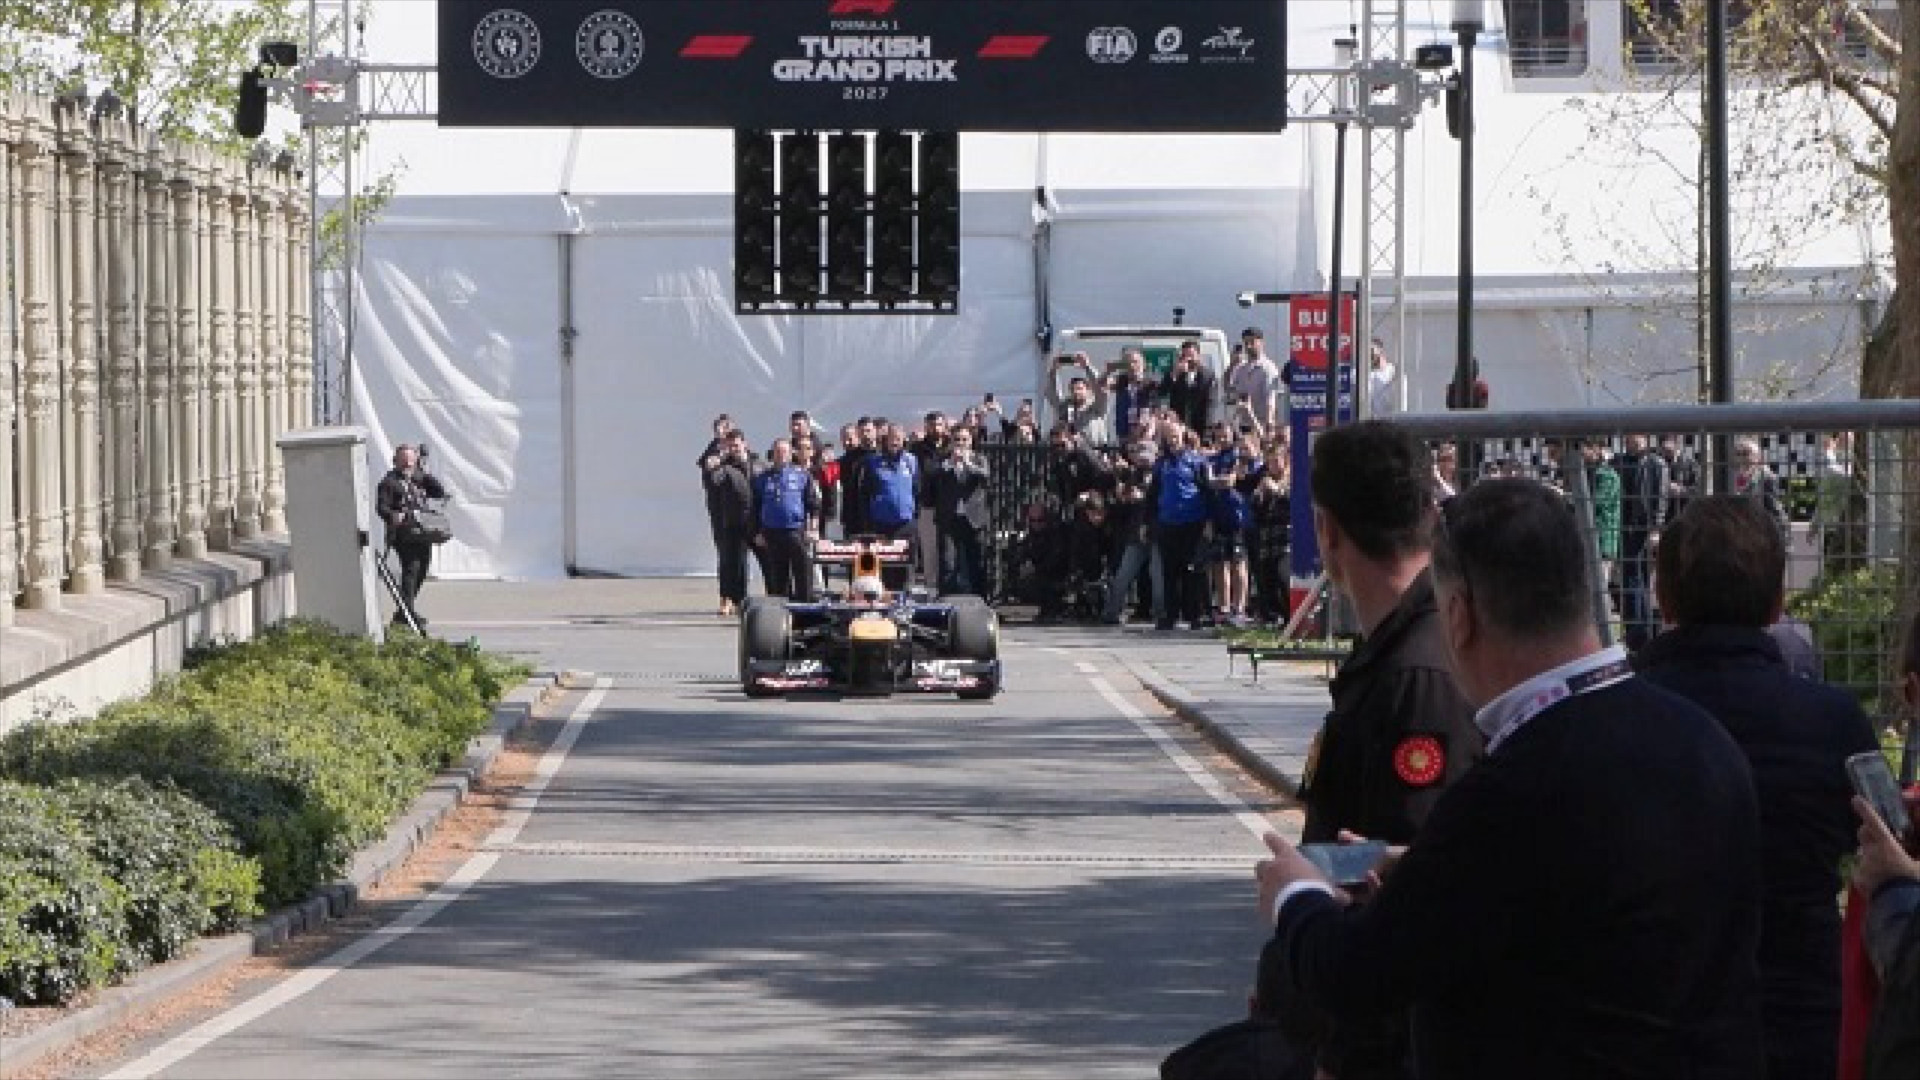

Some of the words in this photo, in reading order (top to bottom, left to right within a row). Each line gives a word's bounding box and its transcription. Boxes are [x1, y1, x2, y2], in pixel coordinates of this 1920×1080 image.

[798, 36, 930, 57] TURKISH
[1091, 35, 1135, 55] FIA
[772, 60, 881, 81] GRAND
[884, 60, 957, 81] PRIX
[842, 86, 889, 100] 2027
[1298, 309, 1332, 327] BU
